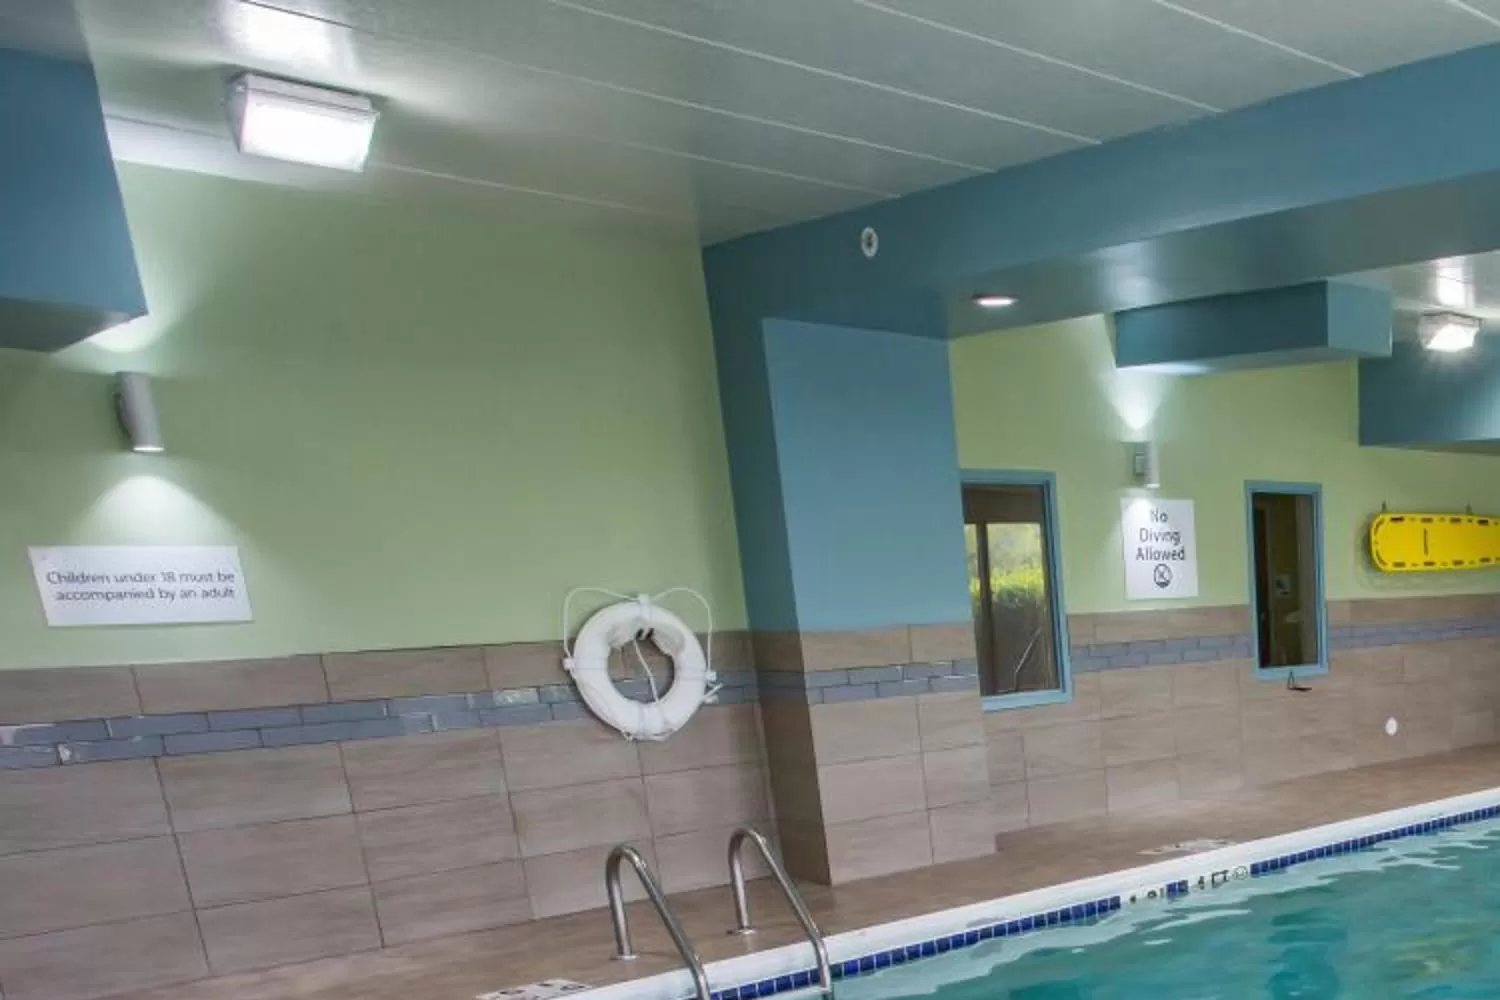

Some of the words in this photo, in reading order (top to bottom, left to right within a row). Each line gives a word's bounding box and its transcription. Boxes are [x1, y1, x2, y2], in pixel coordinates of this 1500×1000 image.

[1149, 508, 1168, 522] No
[1139, 527, 1181, 546] Diving
[1135, 546, 1185, 561] Allowed
[46, 570, 111, 585] Children
[114, 571, 156, 584] under
[160, 570, 176, 582] 18
[179, 572, 213, 583] must
[217, 569, 235, 583] be
[56, 587, 155, 602] accompanied
[157, 587, 175, 602] by
[180, 588, 197, 600] an
[201, 587, 235, 600] adult
